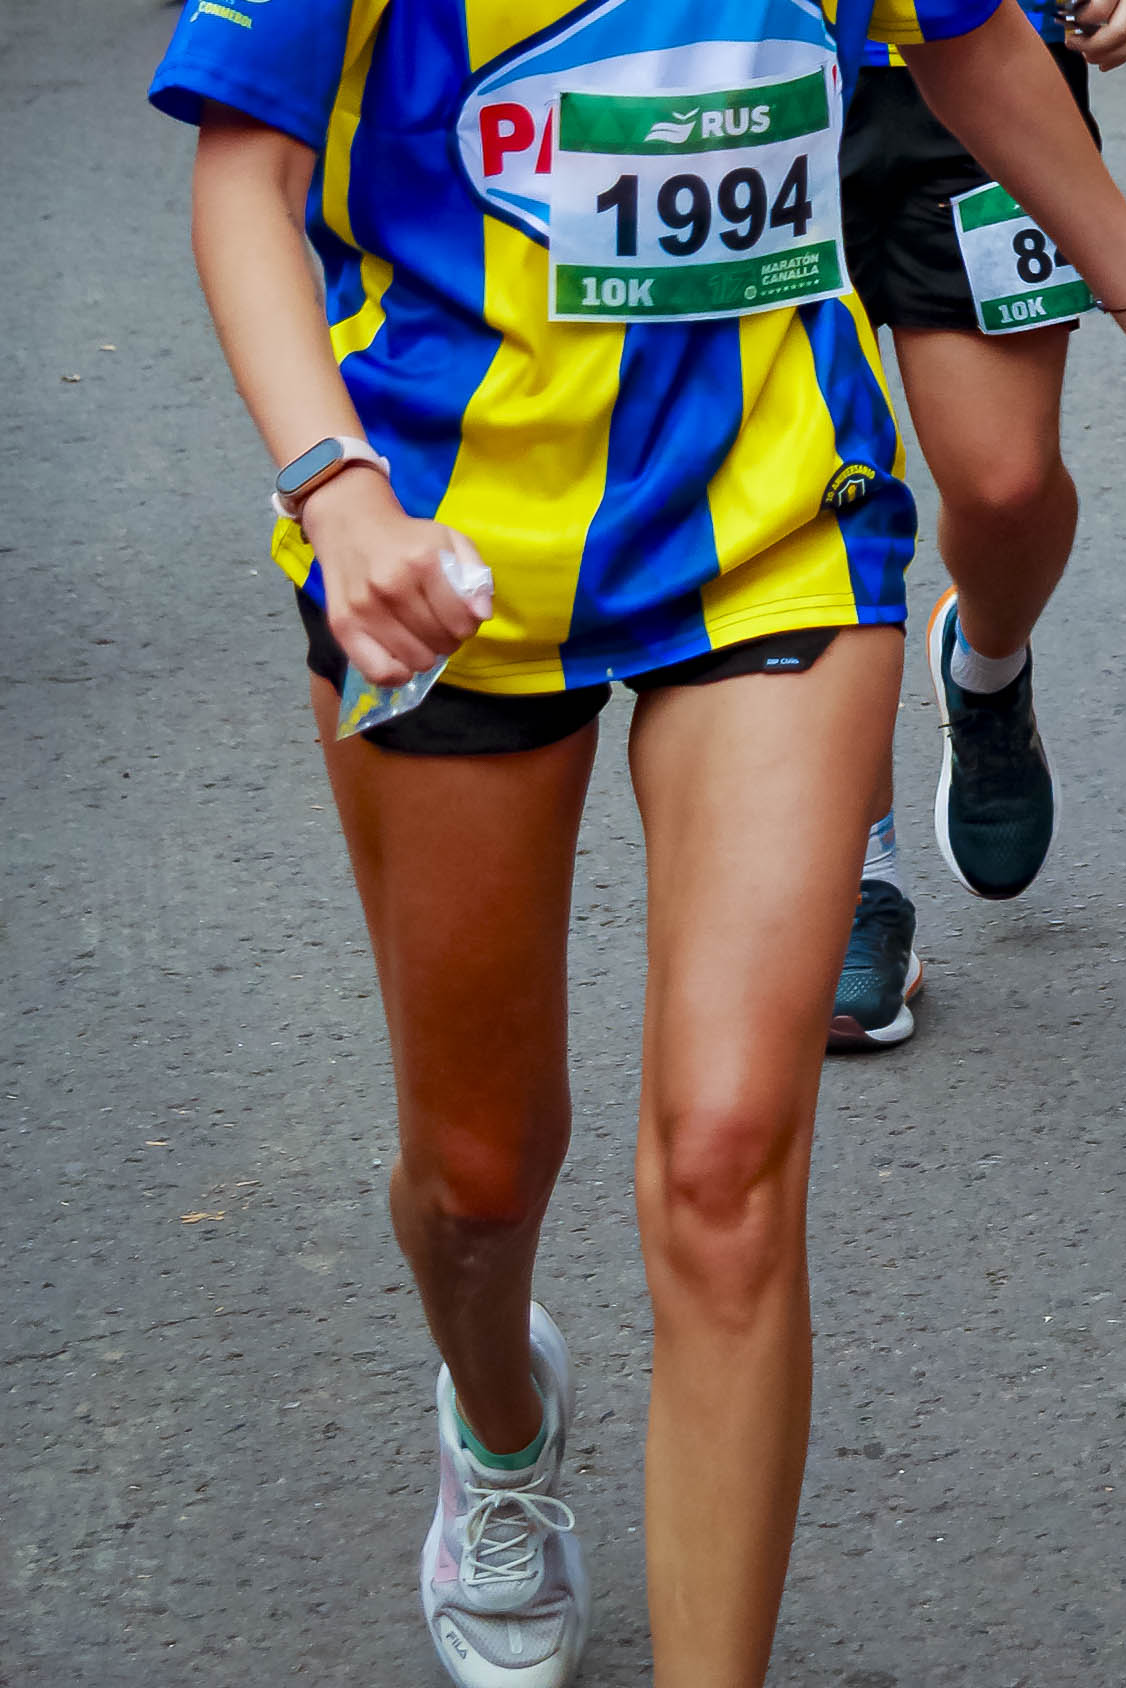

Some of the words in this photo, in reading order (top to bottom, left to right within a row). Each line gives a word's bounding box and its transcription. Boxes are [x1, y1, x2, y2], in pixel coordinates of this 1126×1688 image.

[701, 104, 771, 138] RUS
[596, 154, 812, 257] 1994
[761, 252, 820, 275] MARATÓN
[1013, 228, 1072, 284] 8
[762, 265, 820, 286] CANALLA
[581, 276, 655, 306] 10K
[998, 296, 1046, 324] 10K
[446, 1631, 467, 1659] FILA
